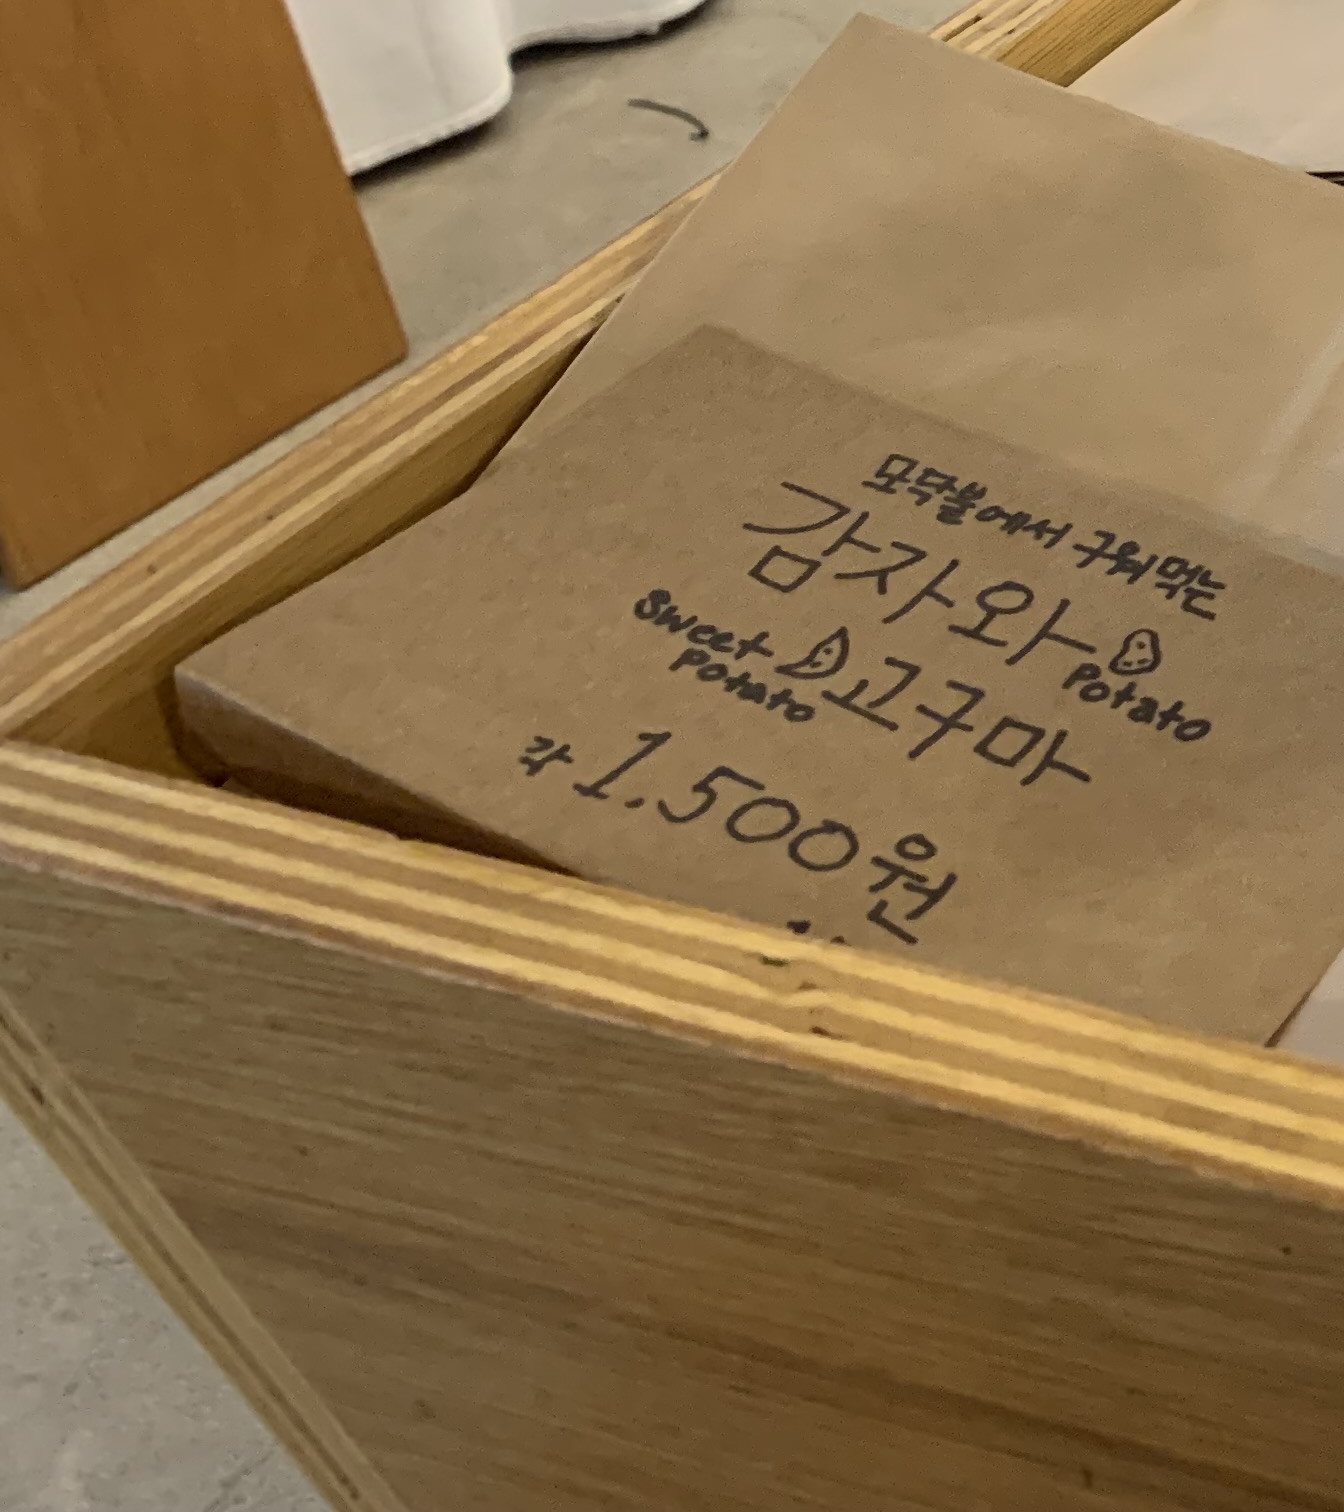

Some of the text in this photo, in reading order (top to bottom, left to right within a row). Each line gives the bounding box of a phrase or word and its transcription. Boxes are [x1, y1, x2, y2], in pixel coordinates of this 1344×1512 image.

[742, 481, 1097, 666] 감자와
[519, 735, 574, 777] 각
[821, 656, 1092, 787] 고구마
